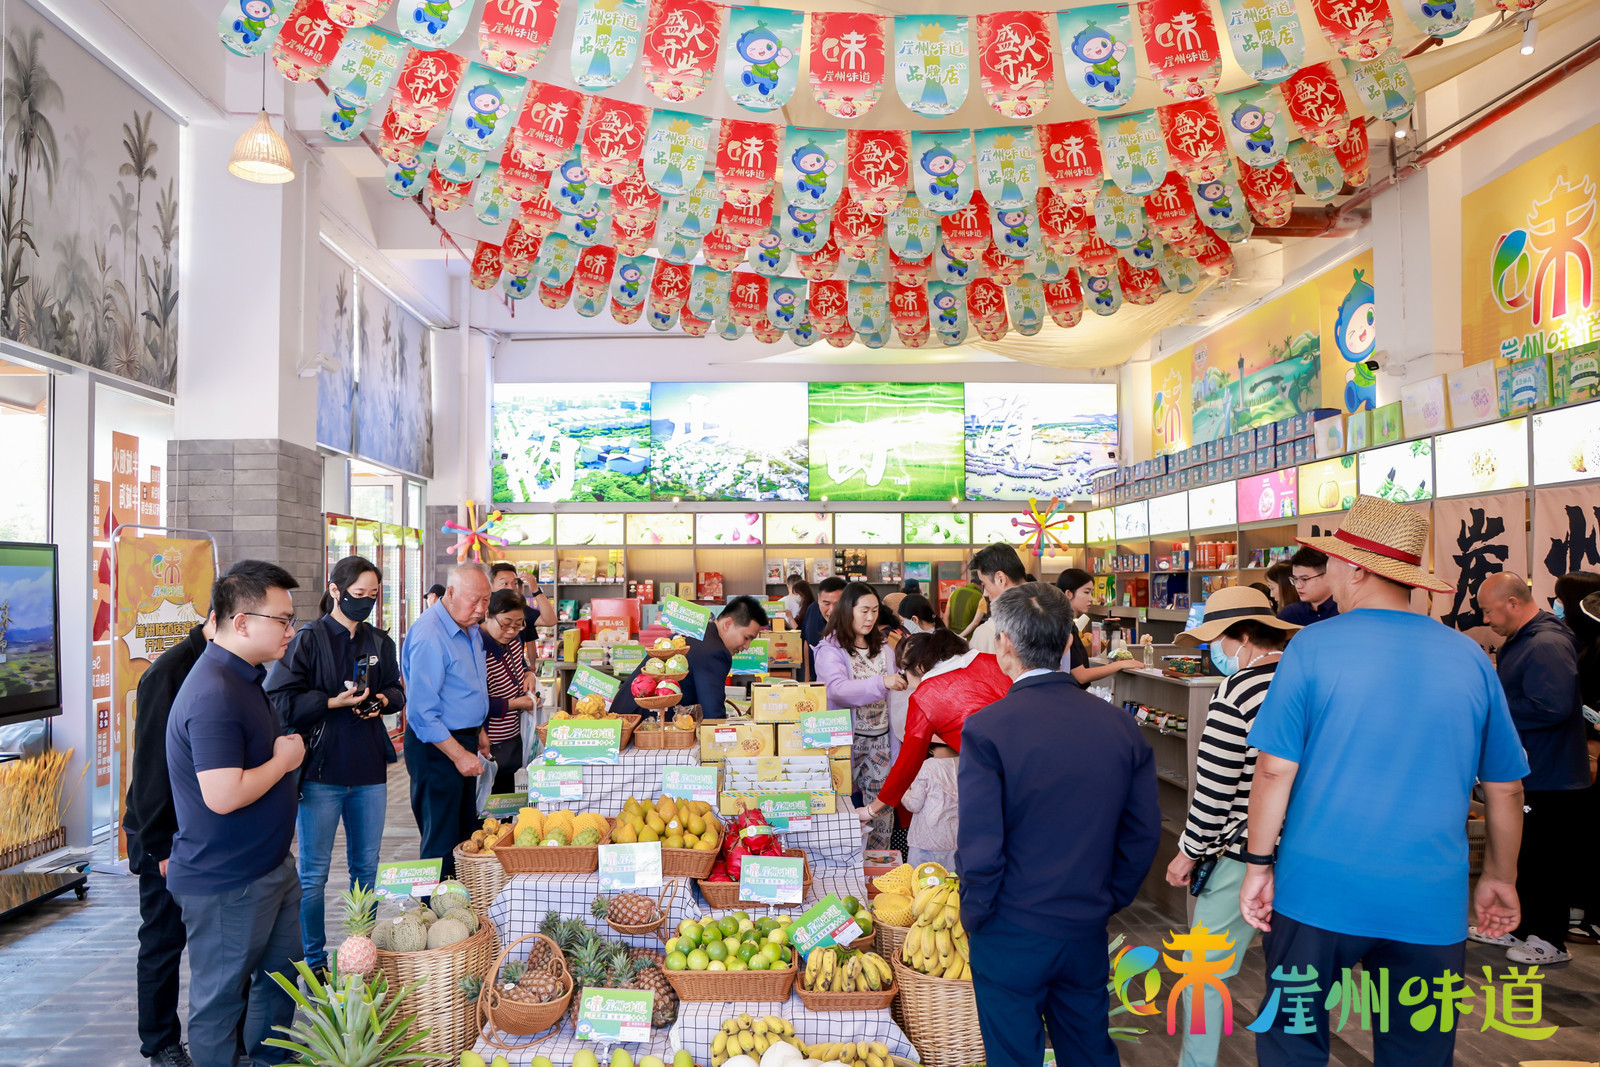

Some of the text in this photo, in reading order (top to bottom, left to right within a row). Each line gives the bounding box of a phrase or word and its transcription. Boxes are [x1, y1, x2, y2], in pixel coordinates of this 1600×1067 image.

[578, 9, 639, 31] 崖州味道
[1230, 1, 1293, 26] 崖州味道
[491, 22, 539, 43] 崖州味道
[285, 39, 324, 63] 崖州味道
[345, 38, 397, 69] 崖州味道
[899, 40, 966, 58] 崖州味道
[1163, 49, 1212, 70] 崖州味道
[1353, 51, 1402, 82] 崖州味道
[822, 69, 873, 84] 崖州味道
[525, 128, 565, 149] 崖州味道
[652, 128, 706, 152] 崖州味道
[1106, 129, 1159, 149] 崖州味道
[980, 149, 1034, 163] 崖州味道
[507, 165, 539, 182] 崖州味道
[725, 166, 767, 180] 崖州味道
[1055, 166, 1095, 179] 崖州味道
[1096, 195, 1141, 209] 崖州味道
[526, 206, 555, 221] 崖州味道
[730, 213, 763, 228] 崖州味道
[891, 206, 935, 220] 崖州味道
[1155, 208, 1188, 221] 崖州味道
[950, 228, 983, 239] 崖州味道
[581, 271, 610, 284] 崖州味道
[693, 277, 728, 292] 崖州味道
[850, 292, 885, 305] 崖州味道
[1009, 286, 1044, 299] 崖州味道
[735, 301, 761, 312] 崖州味道
[896, 310, 922, 319] 崖州味道
